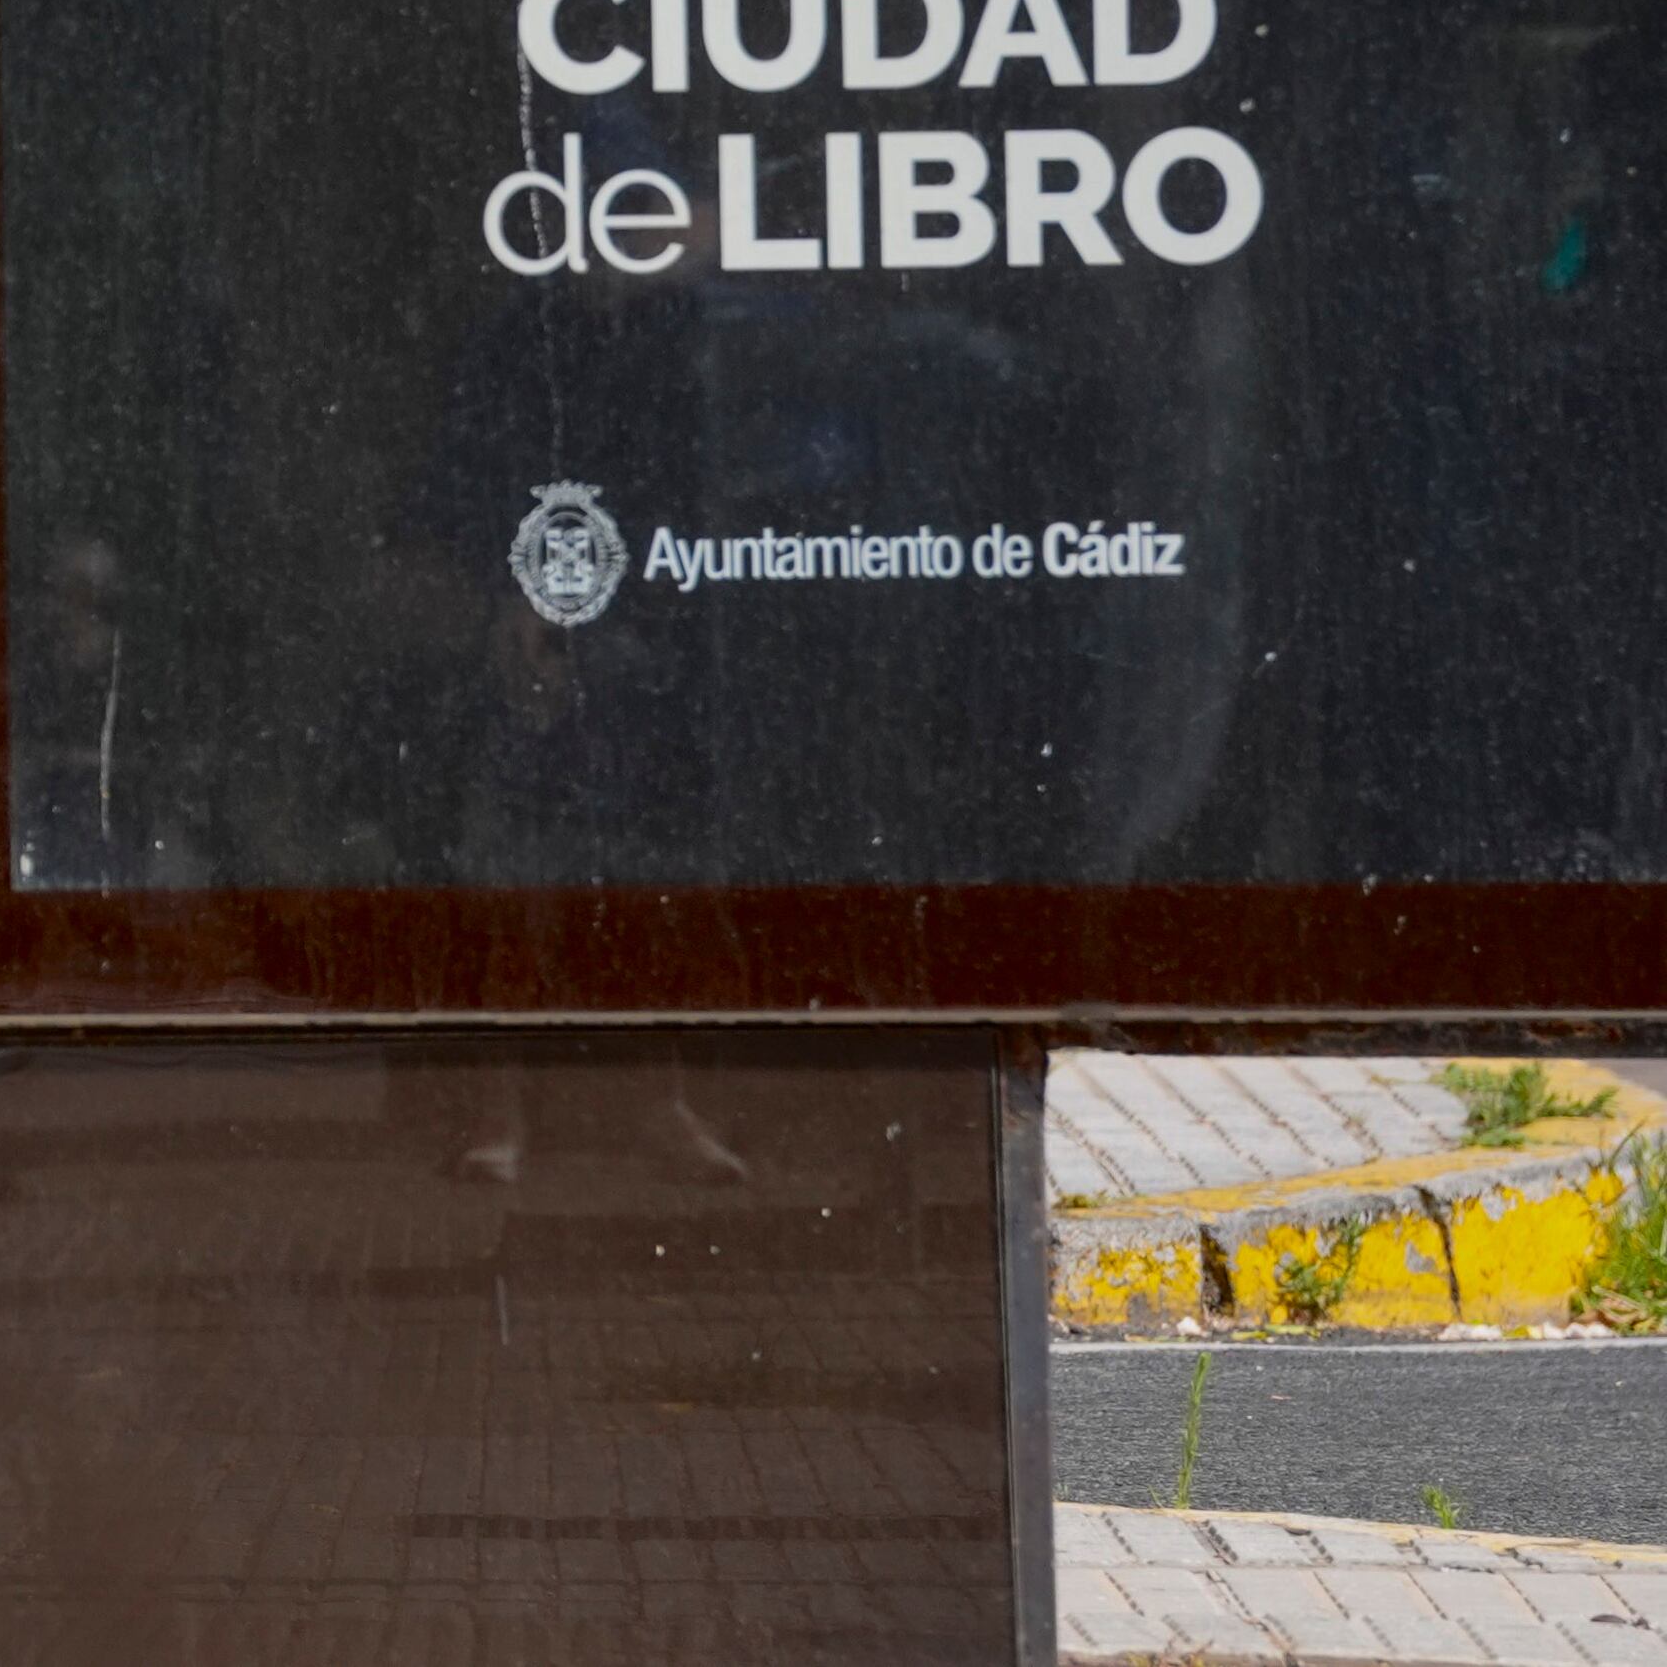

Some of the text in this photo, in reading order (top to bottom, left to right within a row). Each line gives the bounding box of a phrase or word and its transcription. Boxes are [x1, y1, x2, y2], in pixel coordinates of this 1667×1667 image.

[483, 126, 1264, 276] de LIBRO
[643, 520, 1186, 593] Ayuntamiento de Cádiz
